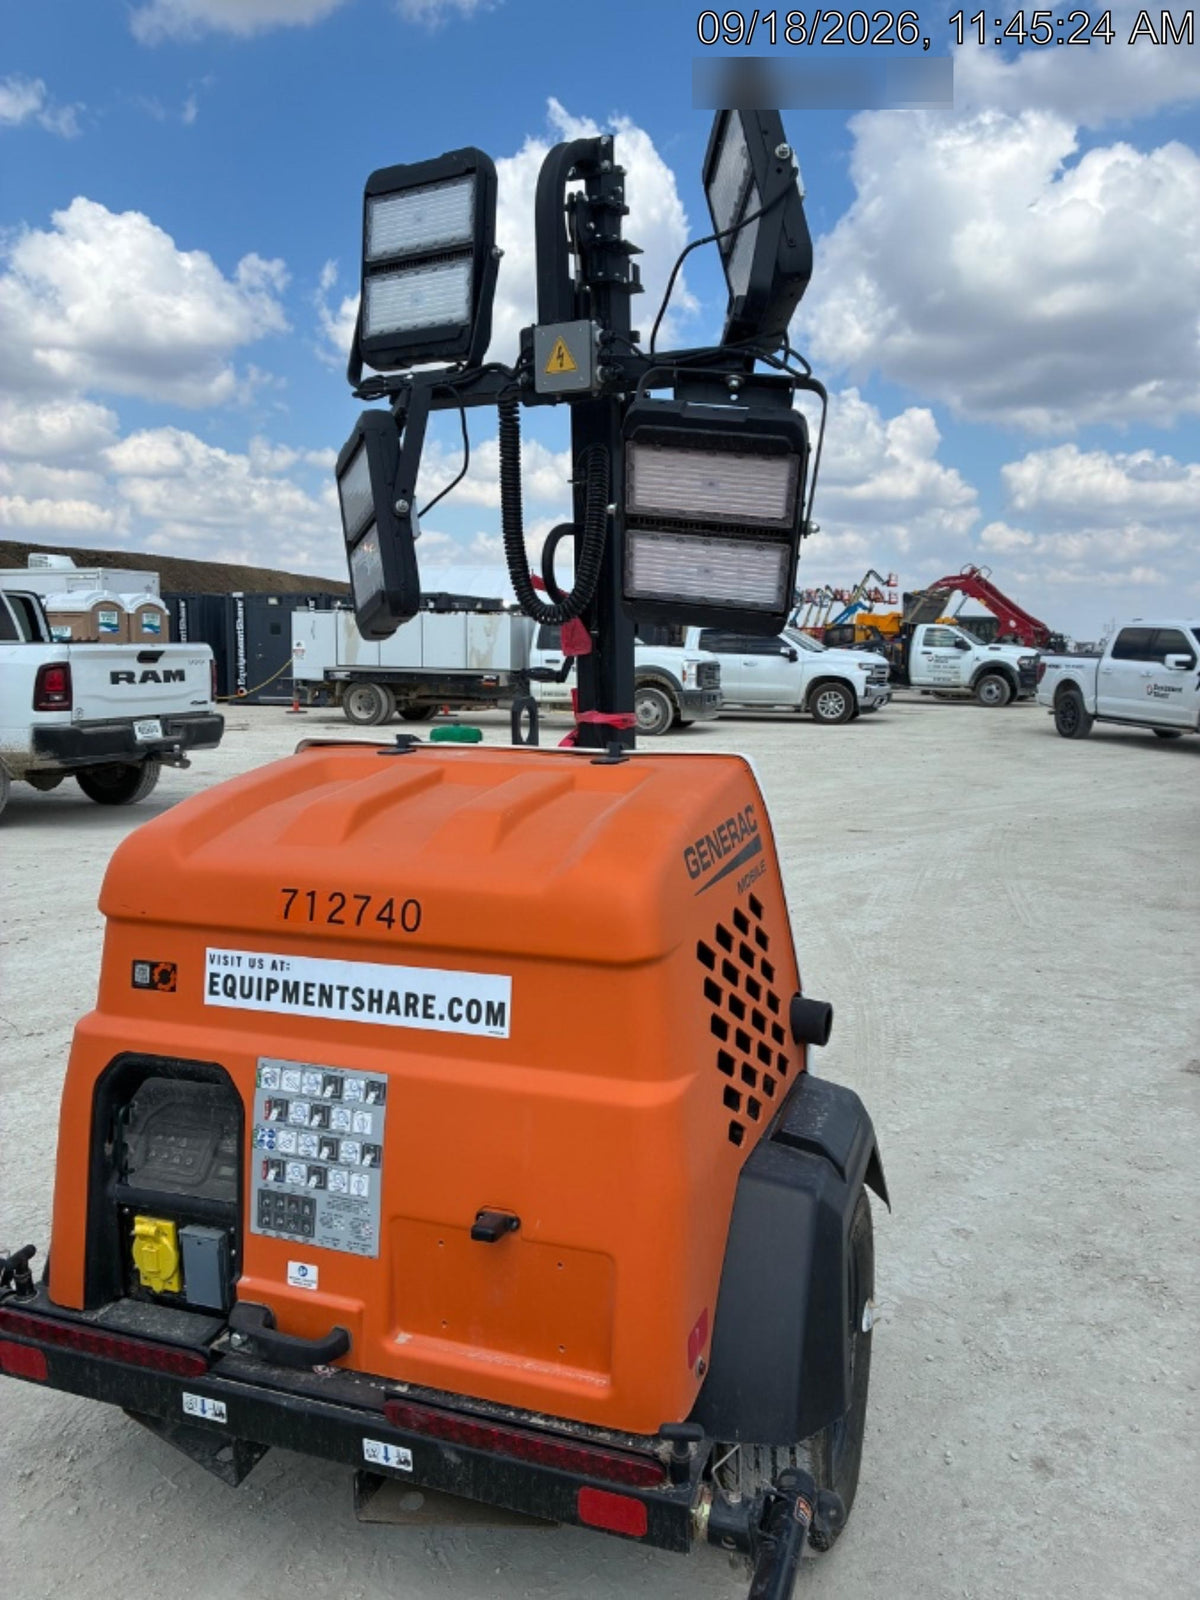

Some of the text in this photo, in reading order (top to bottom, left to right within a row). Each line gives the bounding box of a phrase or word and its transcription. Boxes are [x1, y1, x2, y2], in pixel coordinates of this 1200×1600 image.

[110, 669, 185, 685] RAM
[684, 804, 758, 879] GENERAC
[281, 888, 421, 932] 712740
[209, 953, 291, 972] VISIT US AT:
[208, 972, 506, 1028] EQUIPMENTSHARE.COM
